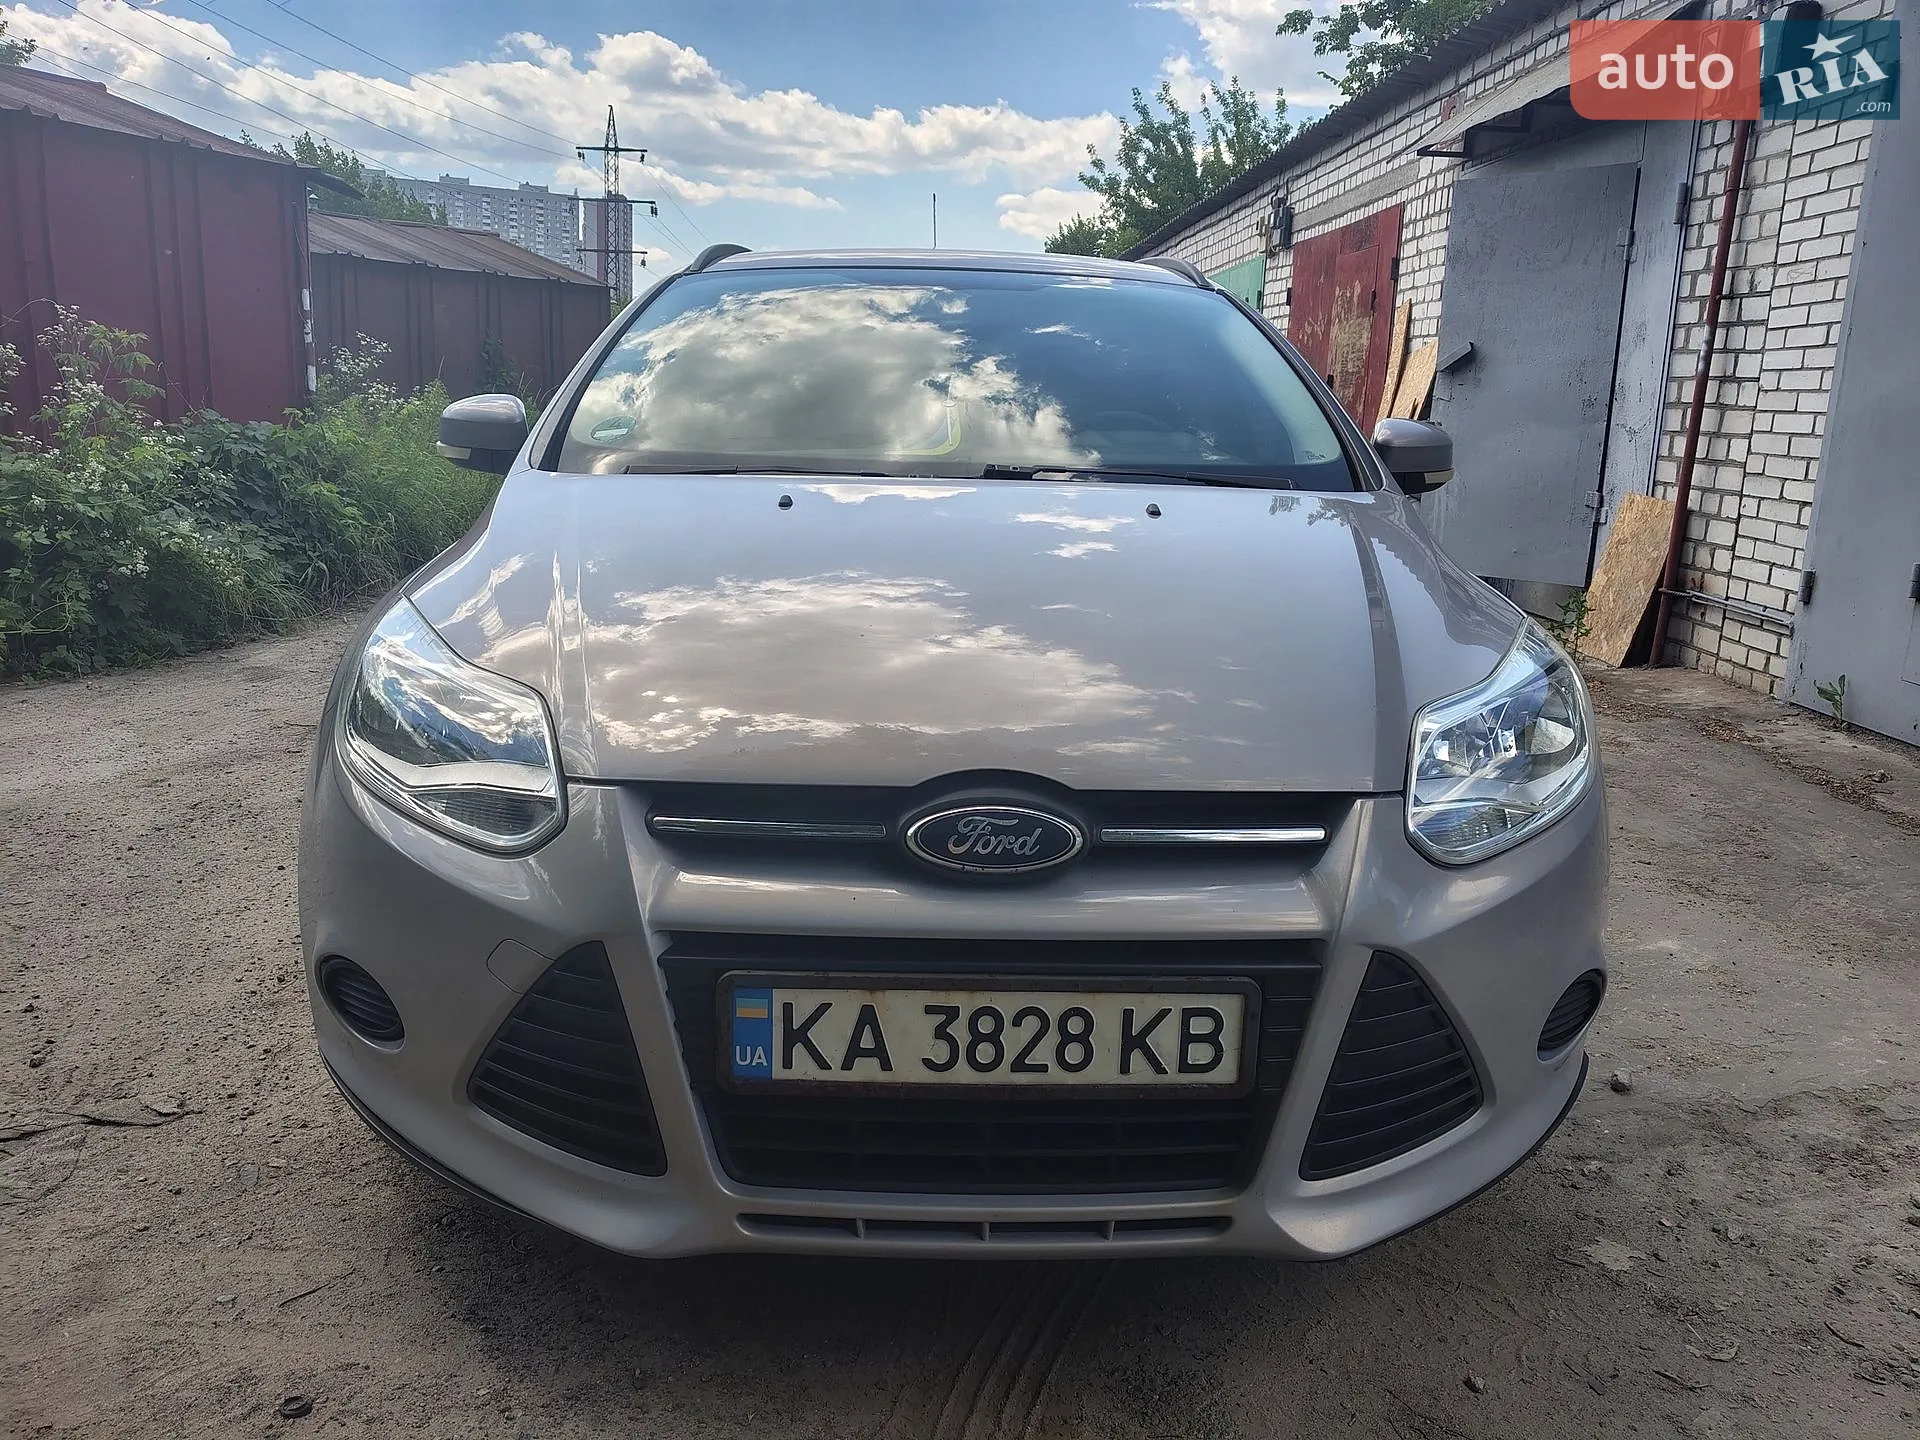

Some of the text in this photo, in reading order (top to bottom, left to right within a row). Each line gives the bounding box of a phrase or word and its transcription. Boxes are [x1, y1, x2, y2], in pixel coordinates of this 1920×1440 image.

[948, 816, 1043, 855] Ford
[735, 1045, 768, 1066] UA
[781, 1001, 1226, 1075] KA 3828 KB
